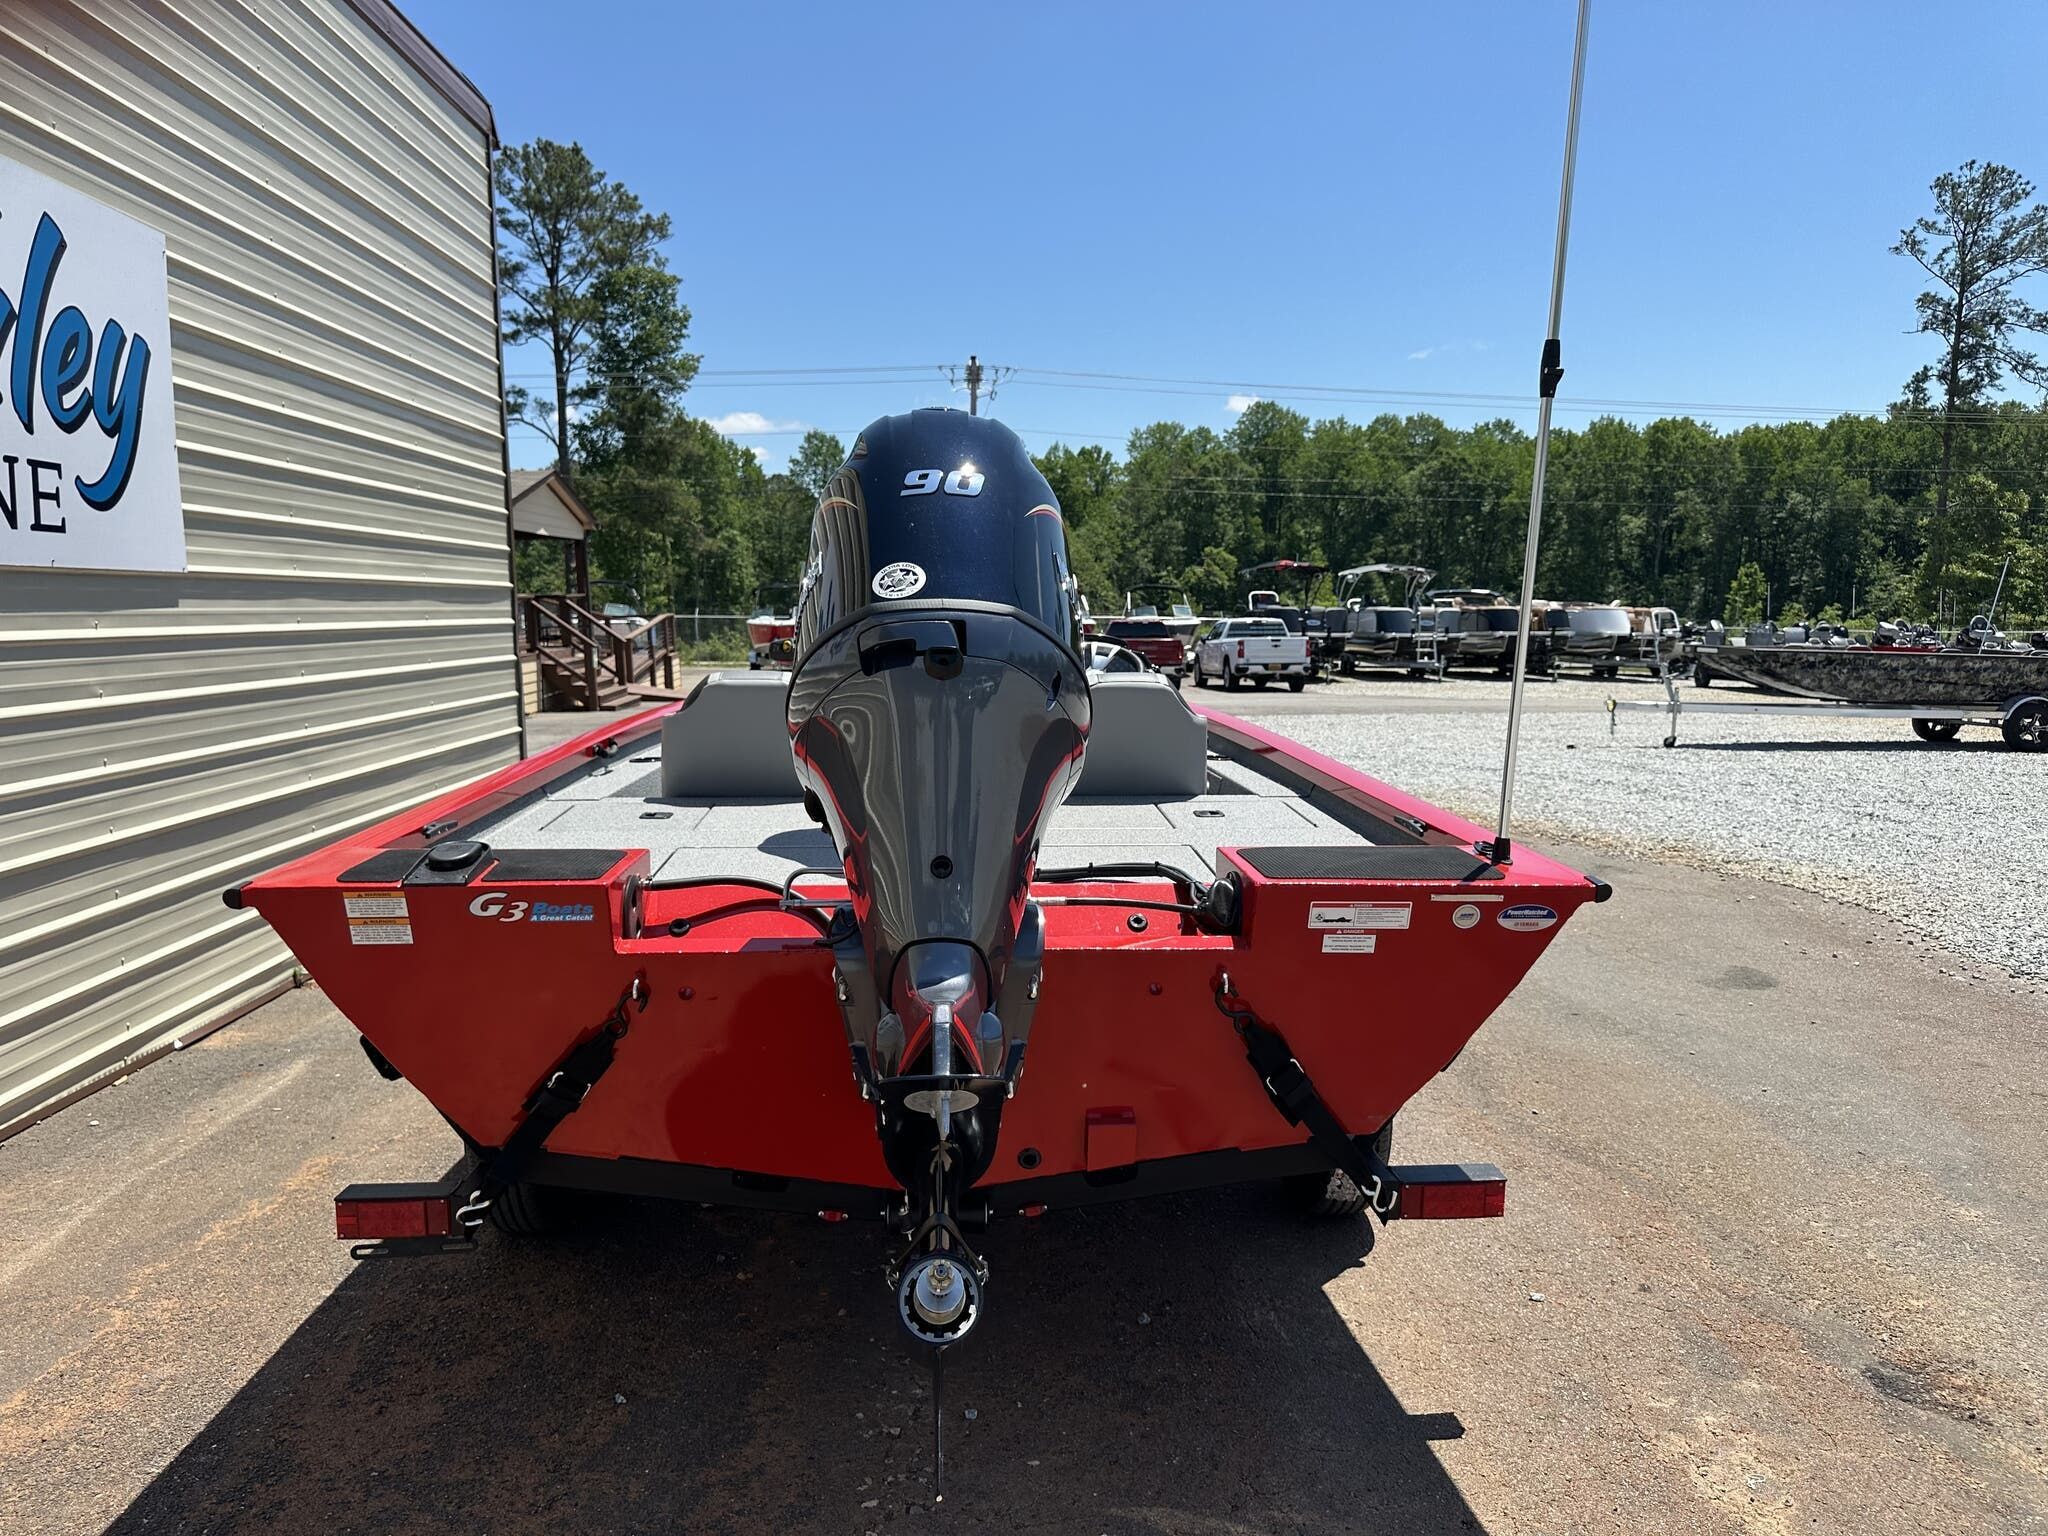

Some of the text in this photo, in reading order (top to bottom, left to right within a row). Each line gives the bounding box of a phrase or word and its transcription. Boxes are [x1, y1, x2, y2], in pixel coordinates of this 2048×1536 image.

[900, 468, 985, 497] 90
[881, 563, 901, 575] ULTRA
[469, 892, 593, 922] G3 Boats
